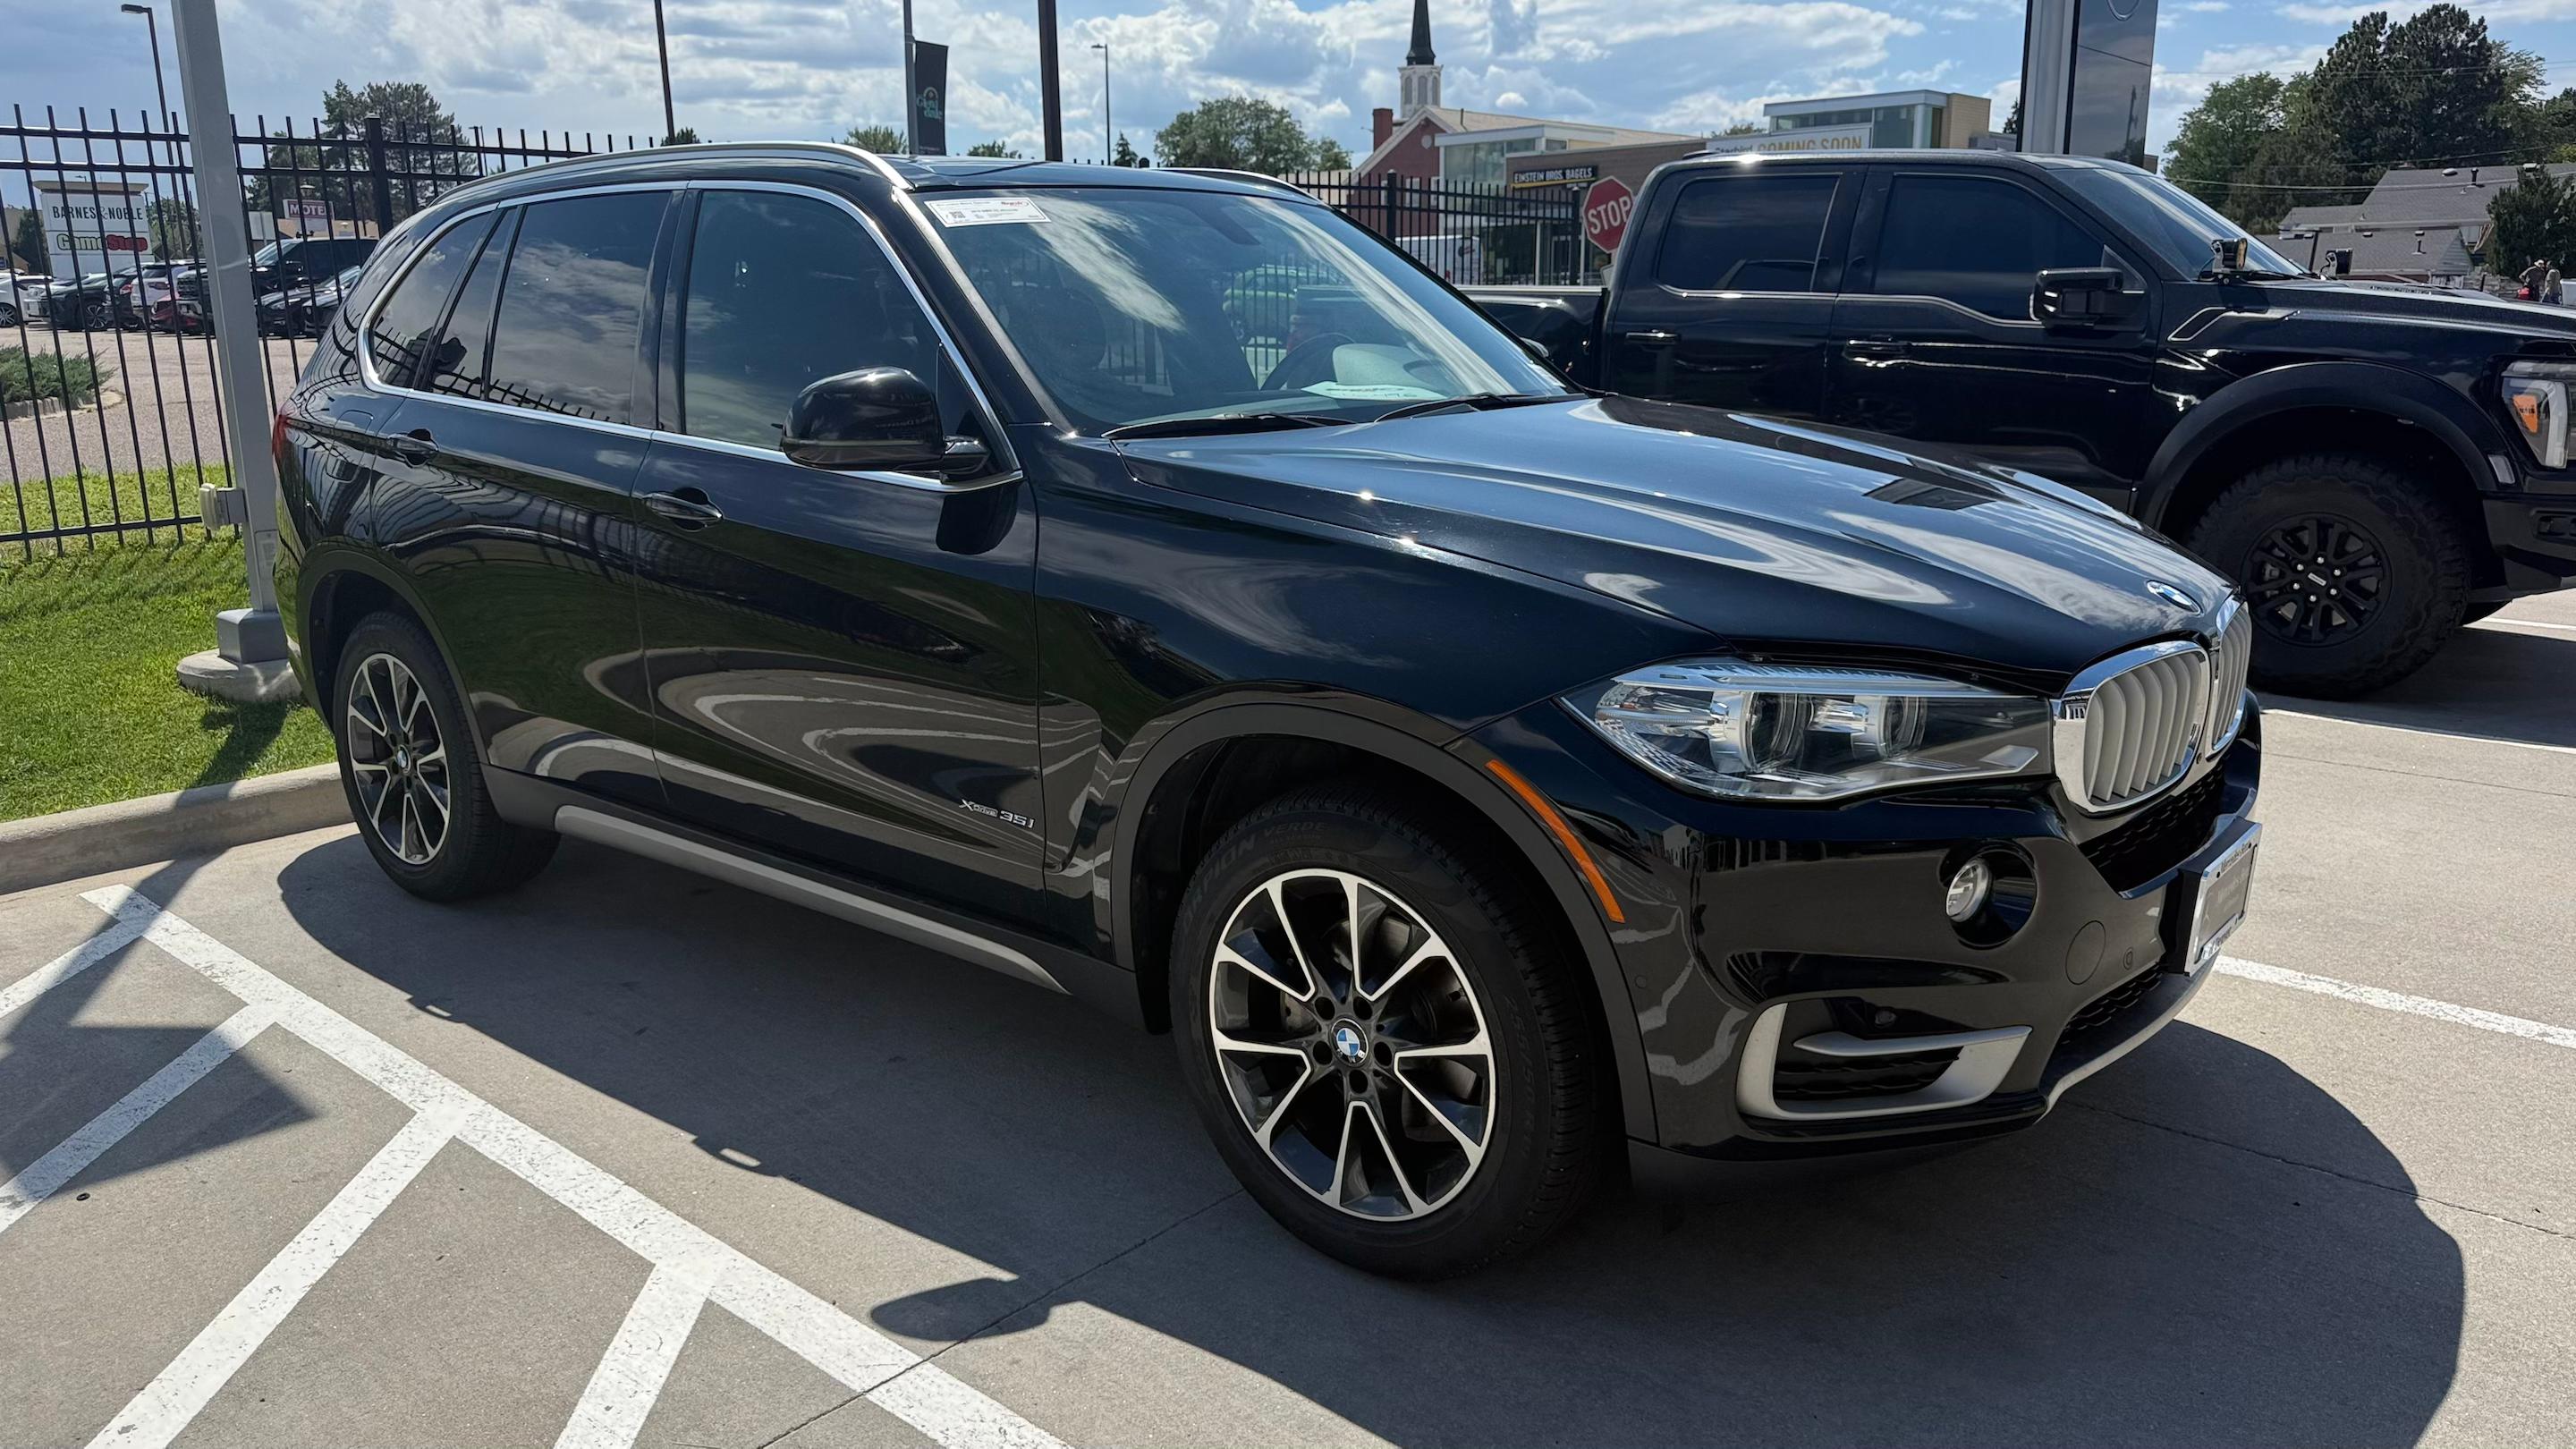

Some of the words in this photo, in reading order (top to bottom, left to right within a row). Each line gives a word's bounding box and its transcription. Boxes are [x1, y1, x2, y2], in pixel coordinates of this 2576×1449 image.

[1514, 172, 1545, 182] EINSTEIN
[1565, 167, 1592, 179] BAGELS
[290, 204, 326, 216] MOTE
[1588, 196, 1631, 234] STOP
